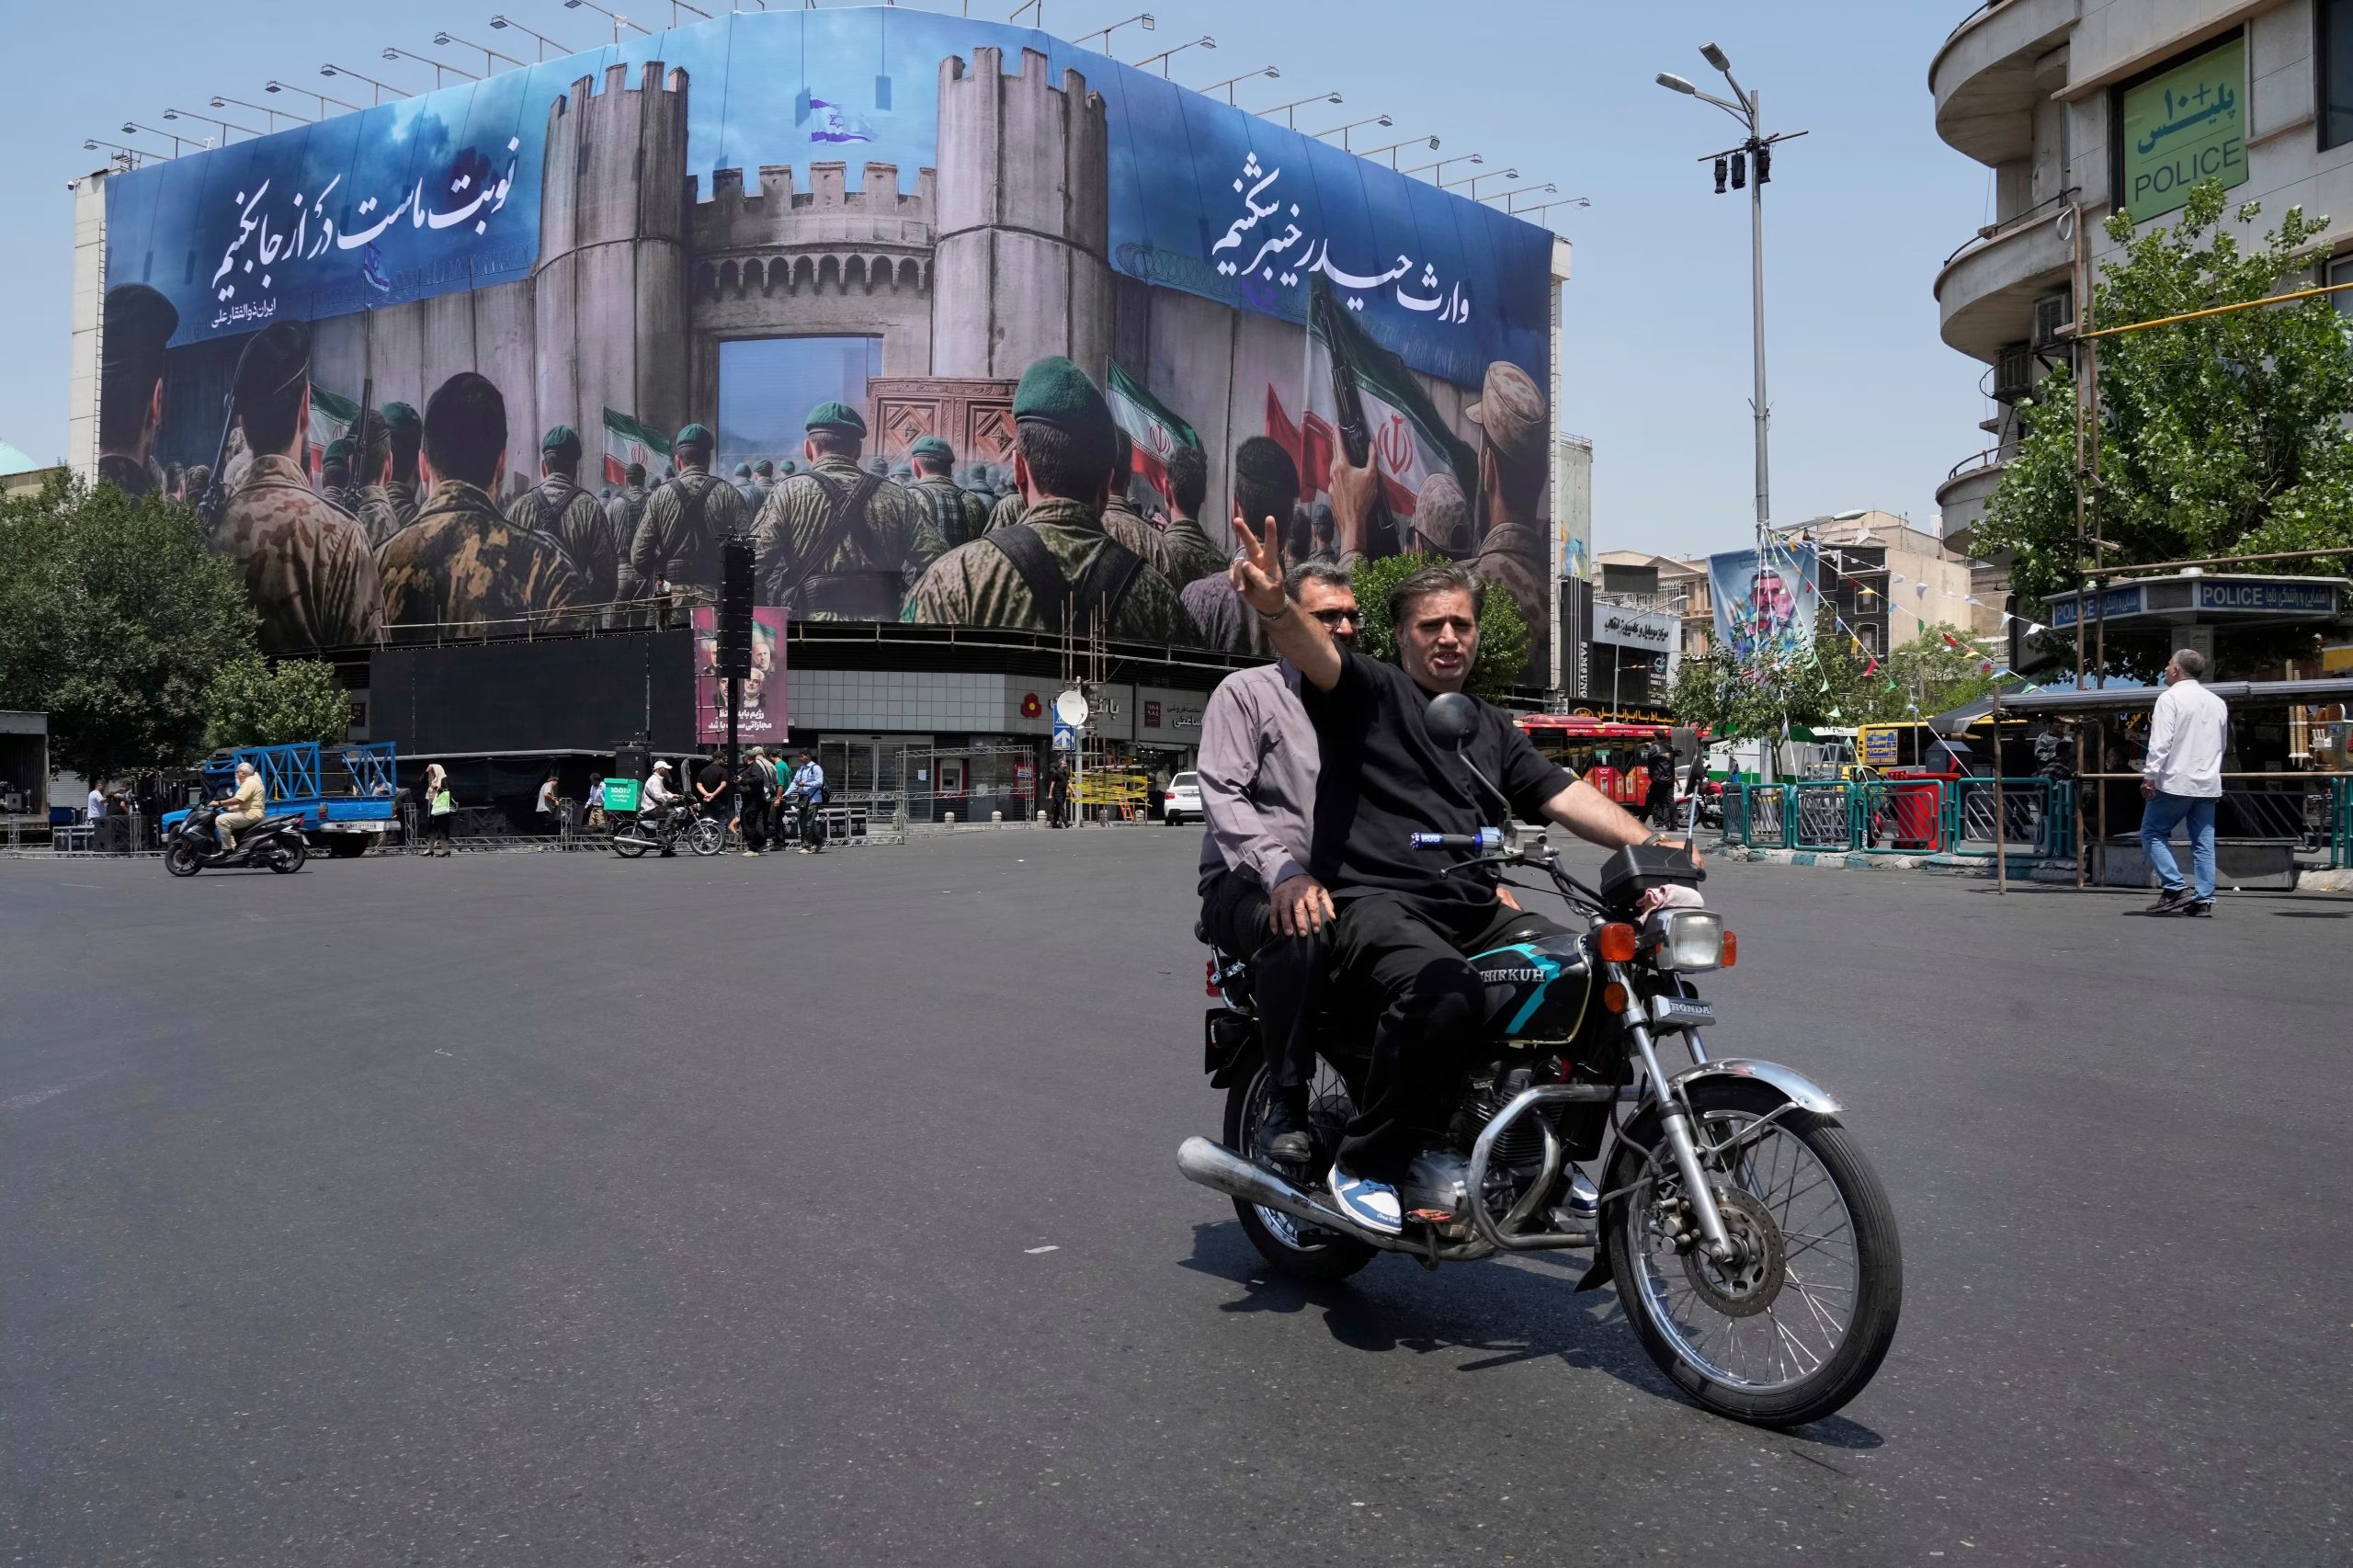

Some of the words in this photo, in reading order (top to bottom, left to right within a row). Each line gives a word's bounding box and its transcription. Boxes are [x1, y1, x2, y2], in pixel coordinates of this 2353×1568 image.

[2138, 83, 2235, 154] پلیس
[428, 136, 519, 235] نوبت
[2135, 137, 2242, 202] POLICE
[211, 178, 270, 301] بکنیم
[281, 192, 307, 261] از
[337, 177, 425, 250] ماست
[1211, 151, 1279, 277] شکنیم
[1241, 203, 1302, 287] خیبر
[259, 213, 283, 289] جا
[1294, 238, 1413, 311] حیدر
[211, 309, 229, 328] علی
[228, 301, 257, 325] ذوالفقار
[256, 297, 277, 317] ایران
[1396, 263, 1470, 324] وارث
[2056, 598, 2096, 622] POLCE
[2202, 586, 2263, 606] POLICE
[1580, 641, 1588, 699] SAMSUNG
[1670, 1002, 1711, 1014] HONDA
